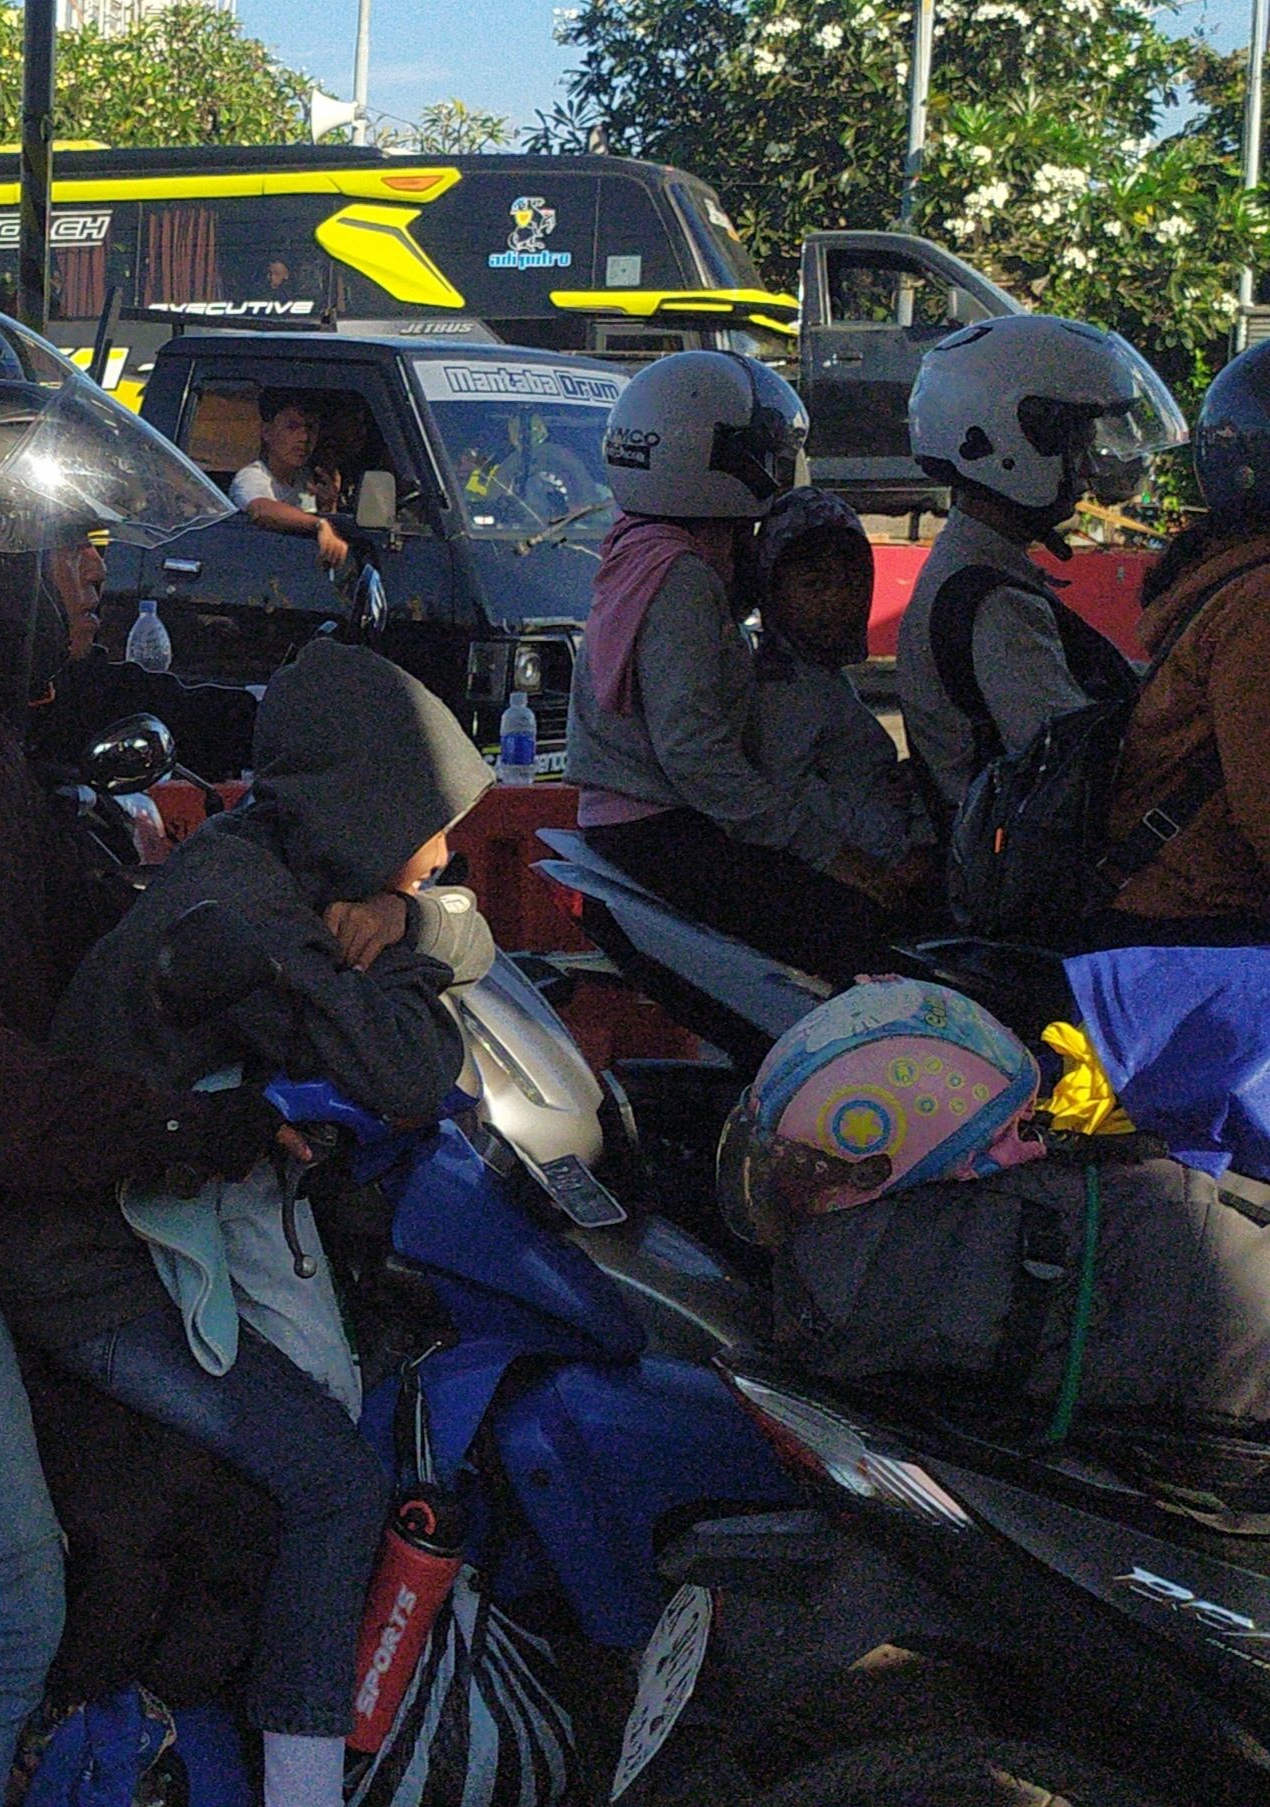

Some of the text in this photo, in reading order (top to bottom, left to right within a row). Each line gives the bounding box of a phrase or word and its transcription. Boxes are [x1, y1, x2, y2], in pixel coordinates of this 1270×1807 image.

[488, 250, 572, 270] adiputro
[400, 323, 474, 335] JETBUS
[444, 366, 620, 400] Mantaba Drum
[355, 1581, 418, 1720] SPORTS
